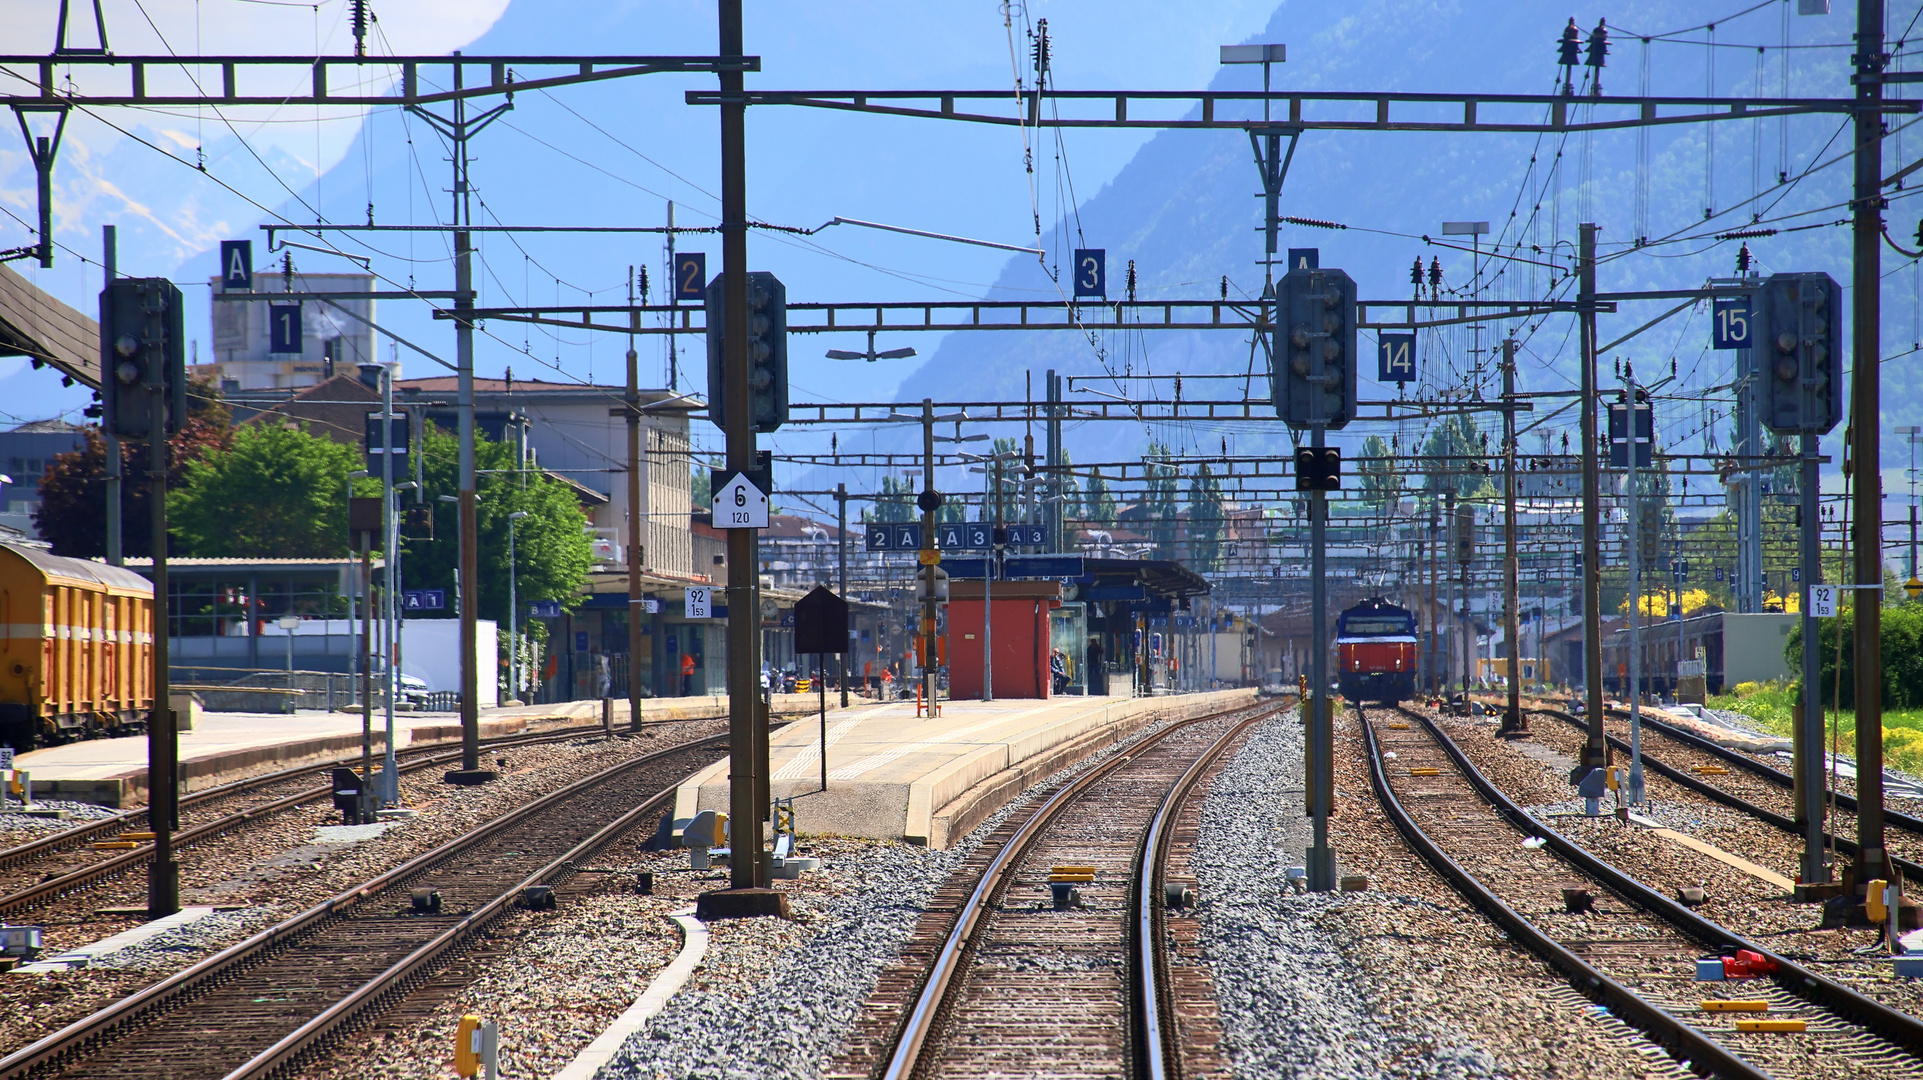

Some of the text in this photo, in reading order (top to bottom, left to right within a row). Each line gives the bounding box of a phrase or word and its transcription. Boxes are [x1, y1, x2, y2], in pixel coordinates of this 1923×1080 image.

[230, 248, 246, 280] A
[682, 261, 699, 292] 2
[1082, 257, 1098, 289] 3
[280, 313, 290, 345] 1
[1717, 309, 1747, 341] 15
[1382, 342, 1411, 373] 14
[734, 485, 746, 507] 6
[732, 512, 750, 523] 120
[875, 532, 914, 546] 2 A
[946, 531, 985, 546] A 3
[1012, 531, 1041, 542] A 3
[1539, 572, 1545, 582] 6
[1793, 569, 1799, 580] 9
[409, 596, 436, 607] A 1
[691, 590, 704, 603] 92
[1816, 588, 1830, 601] 92
[531, 605, 554, 615] B 1
